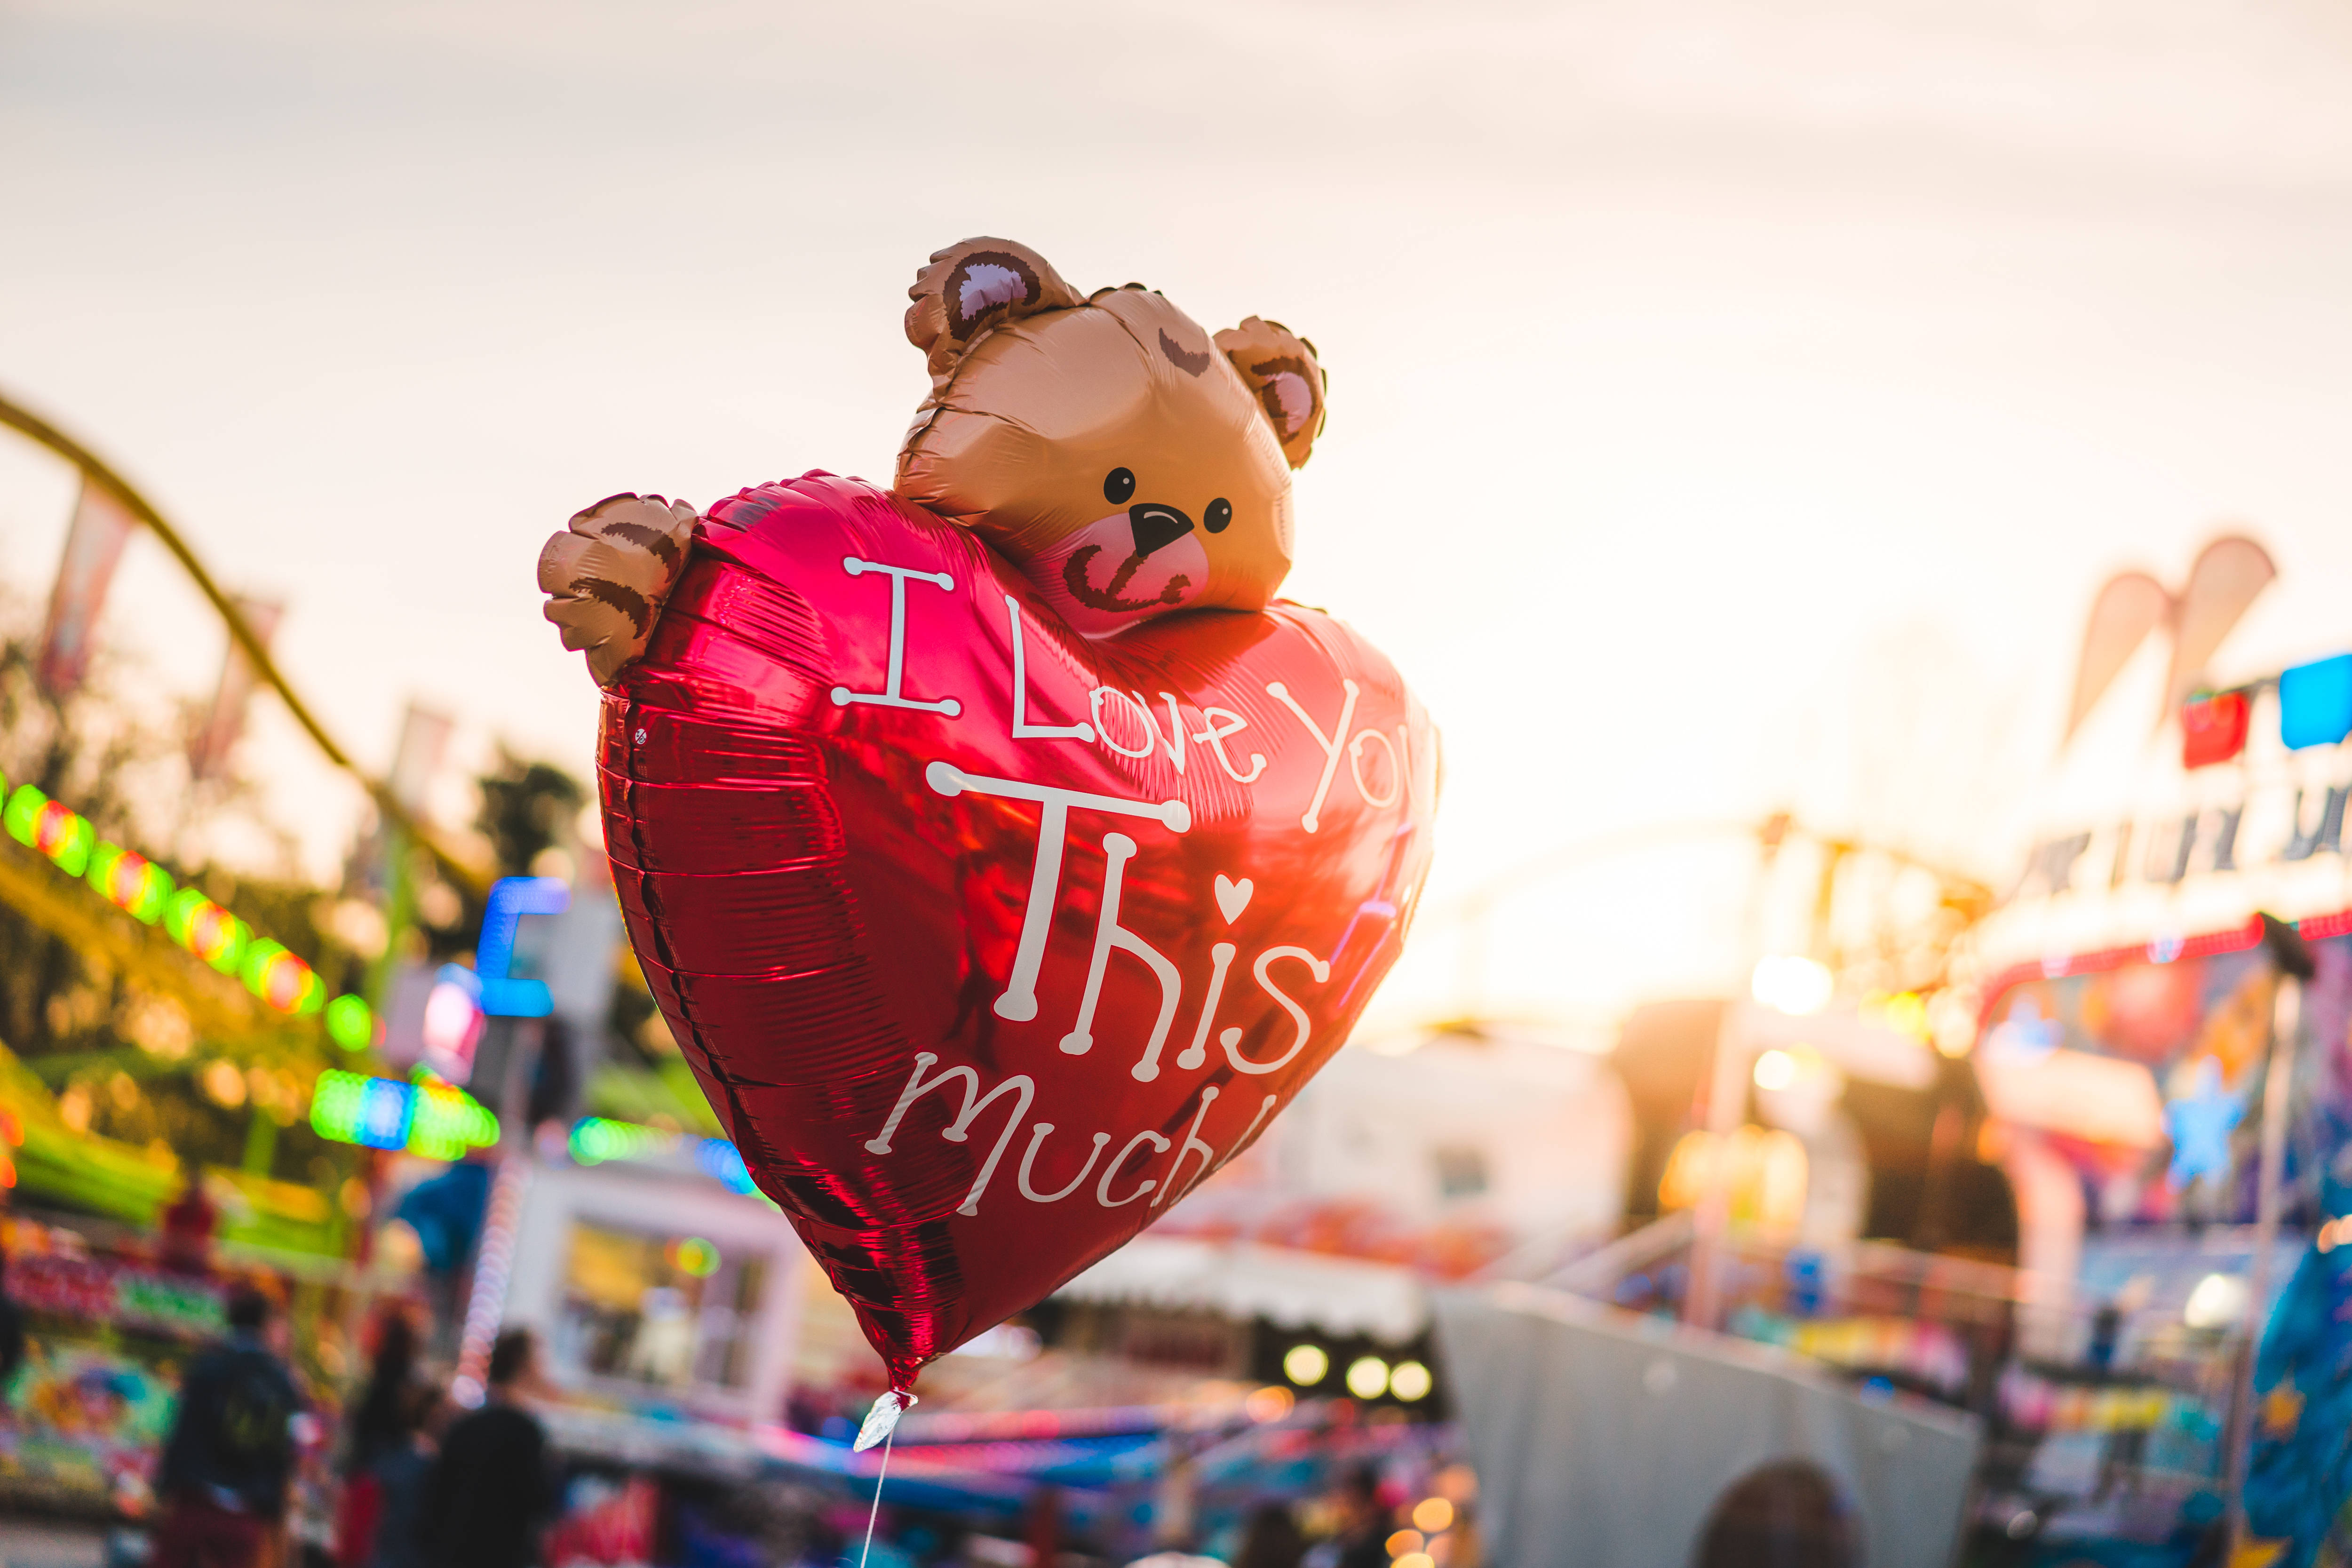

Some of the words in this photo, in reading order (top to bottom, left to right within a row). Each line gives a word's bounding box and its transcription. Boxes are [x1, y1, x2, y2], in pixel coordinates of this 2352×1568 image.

[830, 556, 961, 717] I
[1004, 594, 1266, 784] Love
[925, 761, 1331, 1082] This
